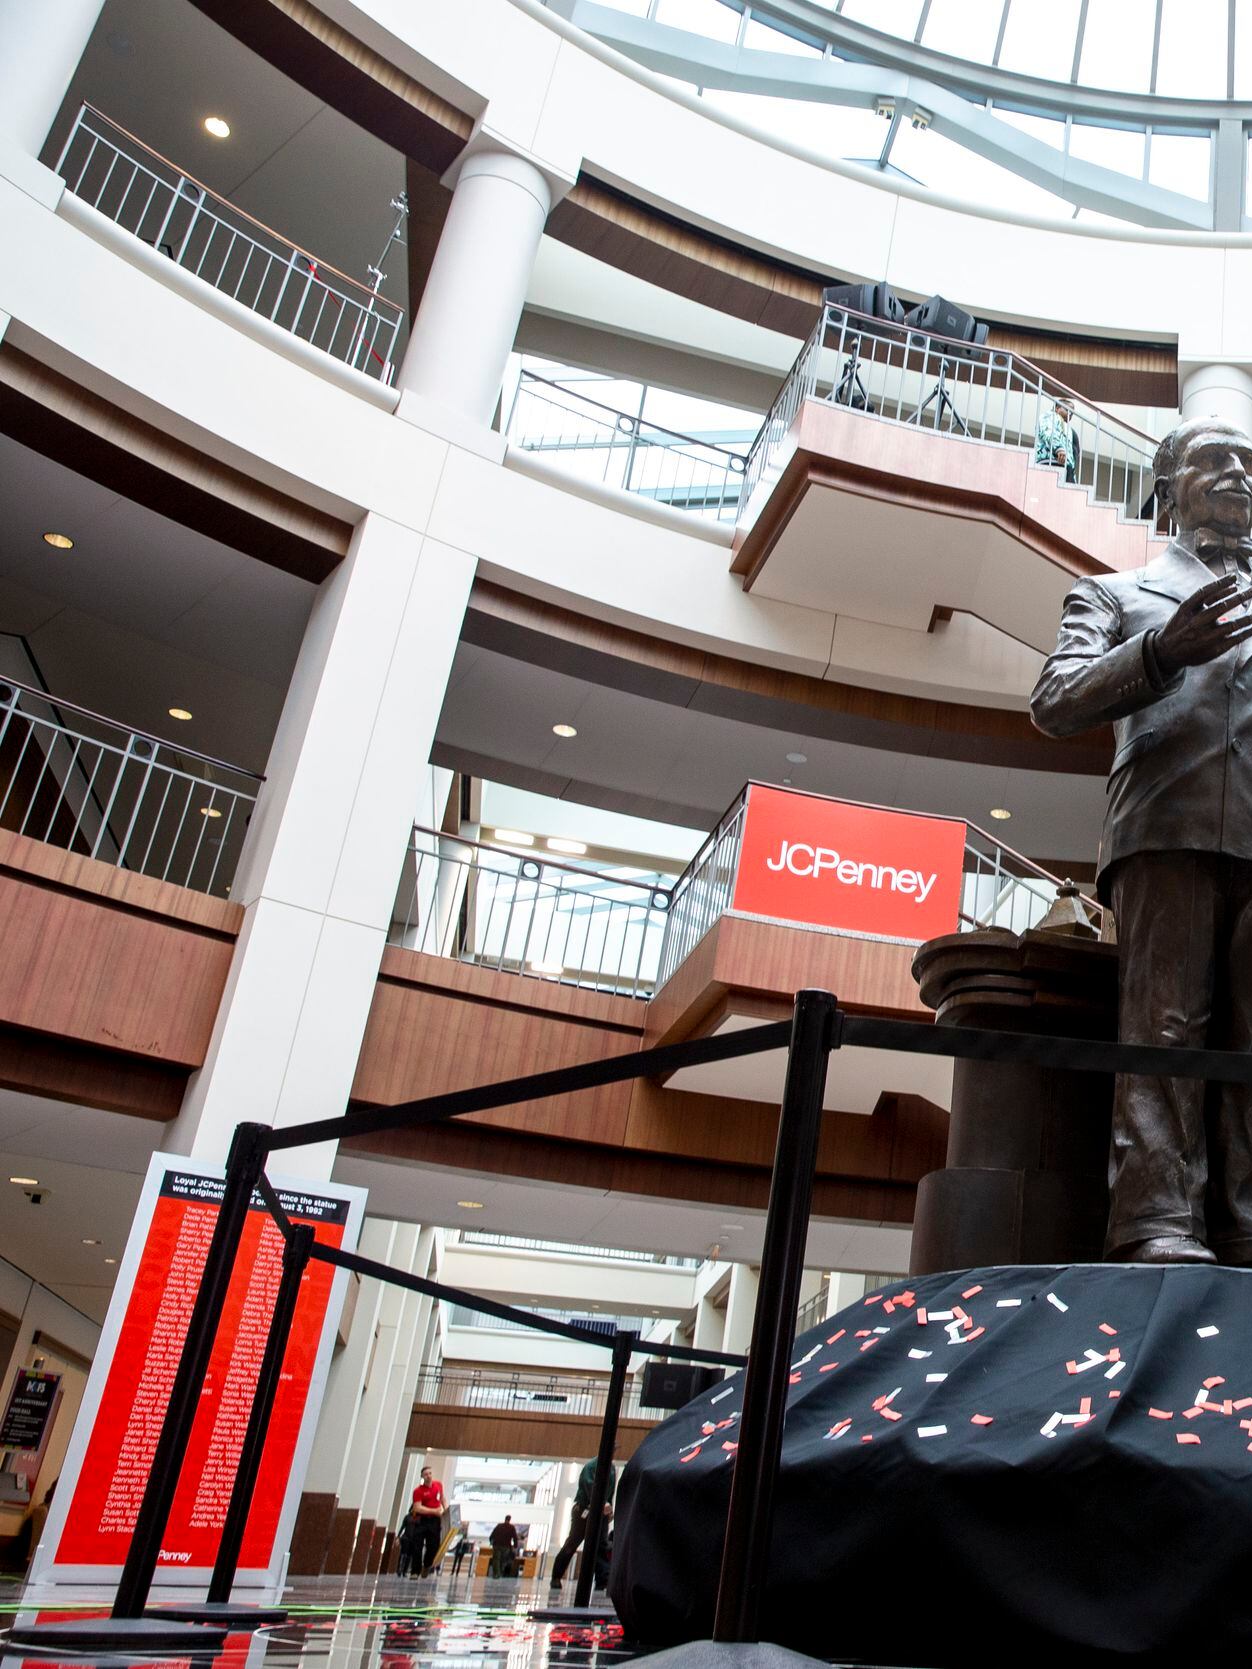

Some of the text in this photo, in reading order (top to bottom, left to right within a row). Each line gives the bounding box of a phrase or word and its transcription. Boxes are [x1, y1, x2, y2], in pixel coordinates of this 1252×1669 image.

[766, 840, 938, 903] JCPenney
[174, 1175, 337, 1210] Loyal JCPenn since the statue
[172, 1184, 189, 1194] was
[306, 1206, 323, 1216] 1992
[127, 1420, 144, 1429] Lynn
[109, 1483, 129, 1491] Scott
[104, 1500, 131, 1509] Cynthia
[103, 1508, 124, 1516] Susan
[100, 1516, 126, 1524] Charles
[98, 1524, 115, 1533] Lynn
[158, 1549, 192, 1563] Penney
